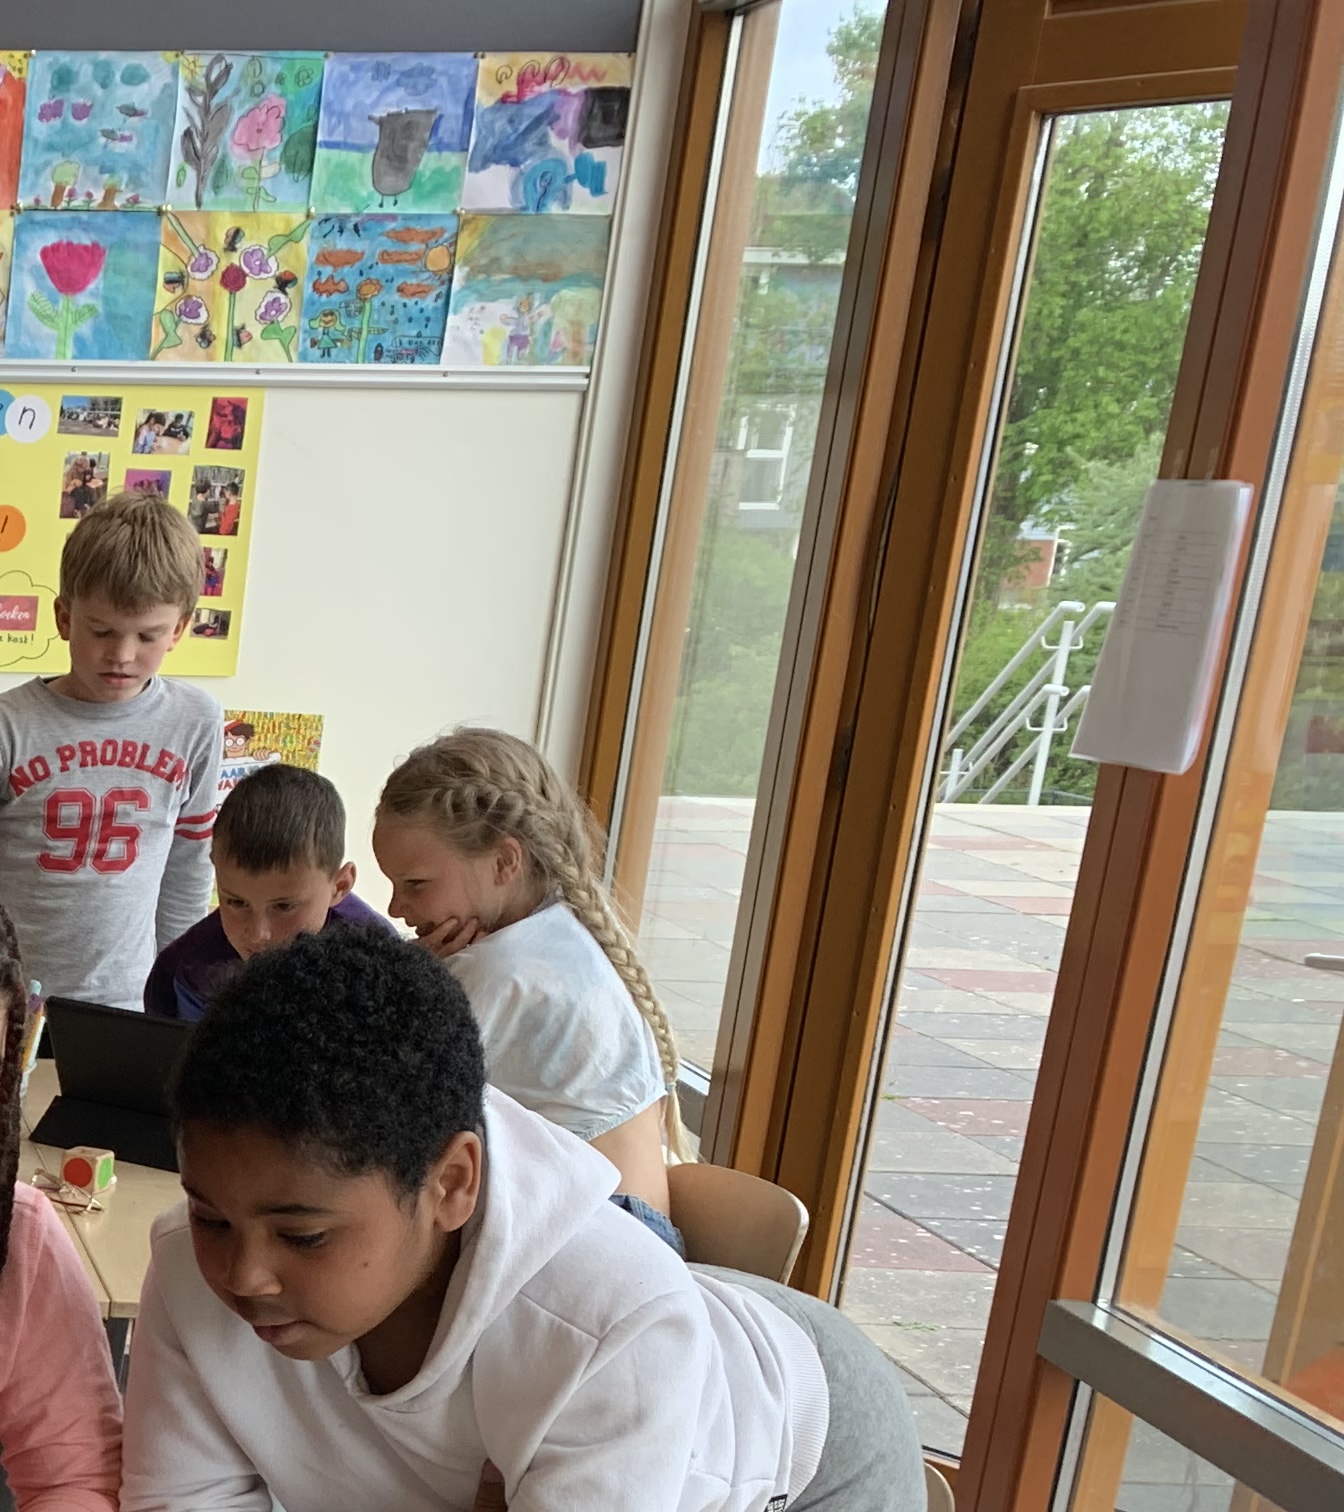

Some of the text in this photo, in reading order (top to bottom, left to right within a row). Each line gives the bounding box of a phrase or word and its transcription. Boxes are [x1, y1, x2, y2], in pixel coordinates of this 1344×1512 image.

[10, 739, 188, 797] NO PROBLEM
[38, 786, 151, 874] 96
